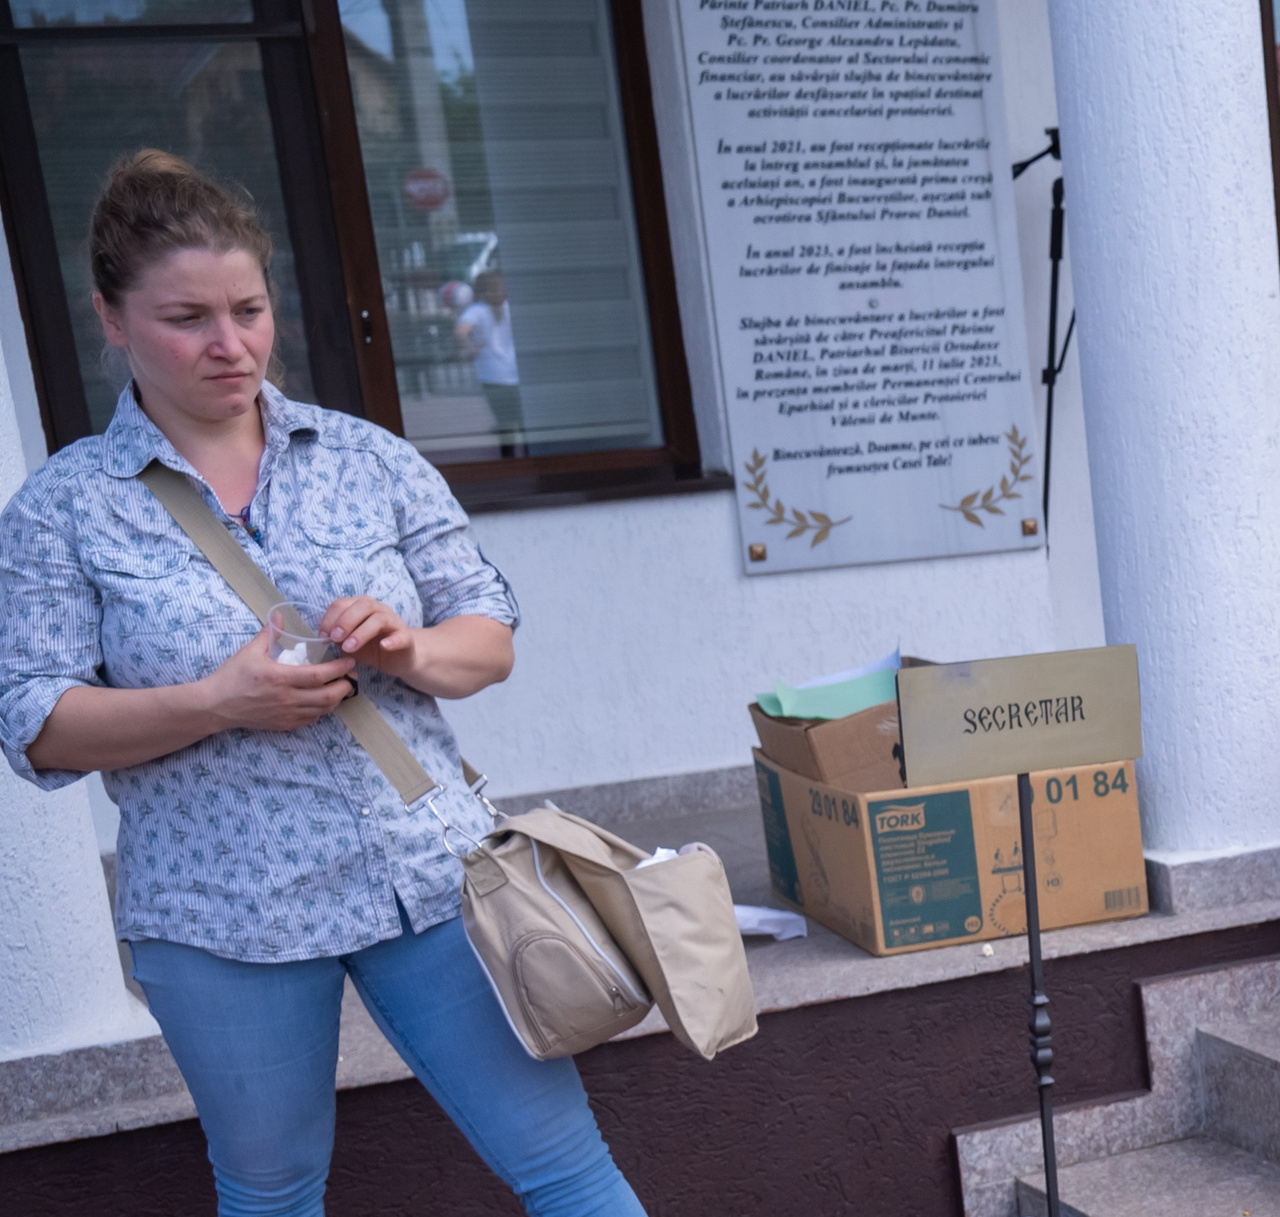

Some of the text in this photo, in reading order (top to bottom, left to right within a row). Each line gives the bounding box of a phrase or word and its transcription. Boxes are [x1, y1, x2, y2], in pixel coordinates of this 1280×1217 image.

[736, 141, 767, 154] anul
[829, 140, 854, 156] fost
[819, 176, 843, 190] fost
[970, 188, 992, 201] sub
[764, 246, 794, 259] anul
[847, 243, 872, 260] fost
[981, 304, 1005, 321] fost
[963, 695, 1085, 734] SECRETAR
[1045, 774, 1079, 804] 01
[1093, 767, 1129, 797] 84
[841, 799, 859, 828] 84
[878, 812, 922, 830] TORK
